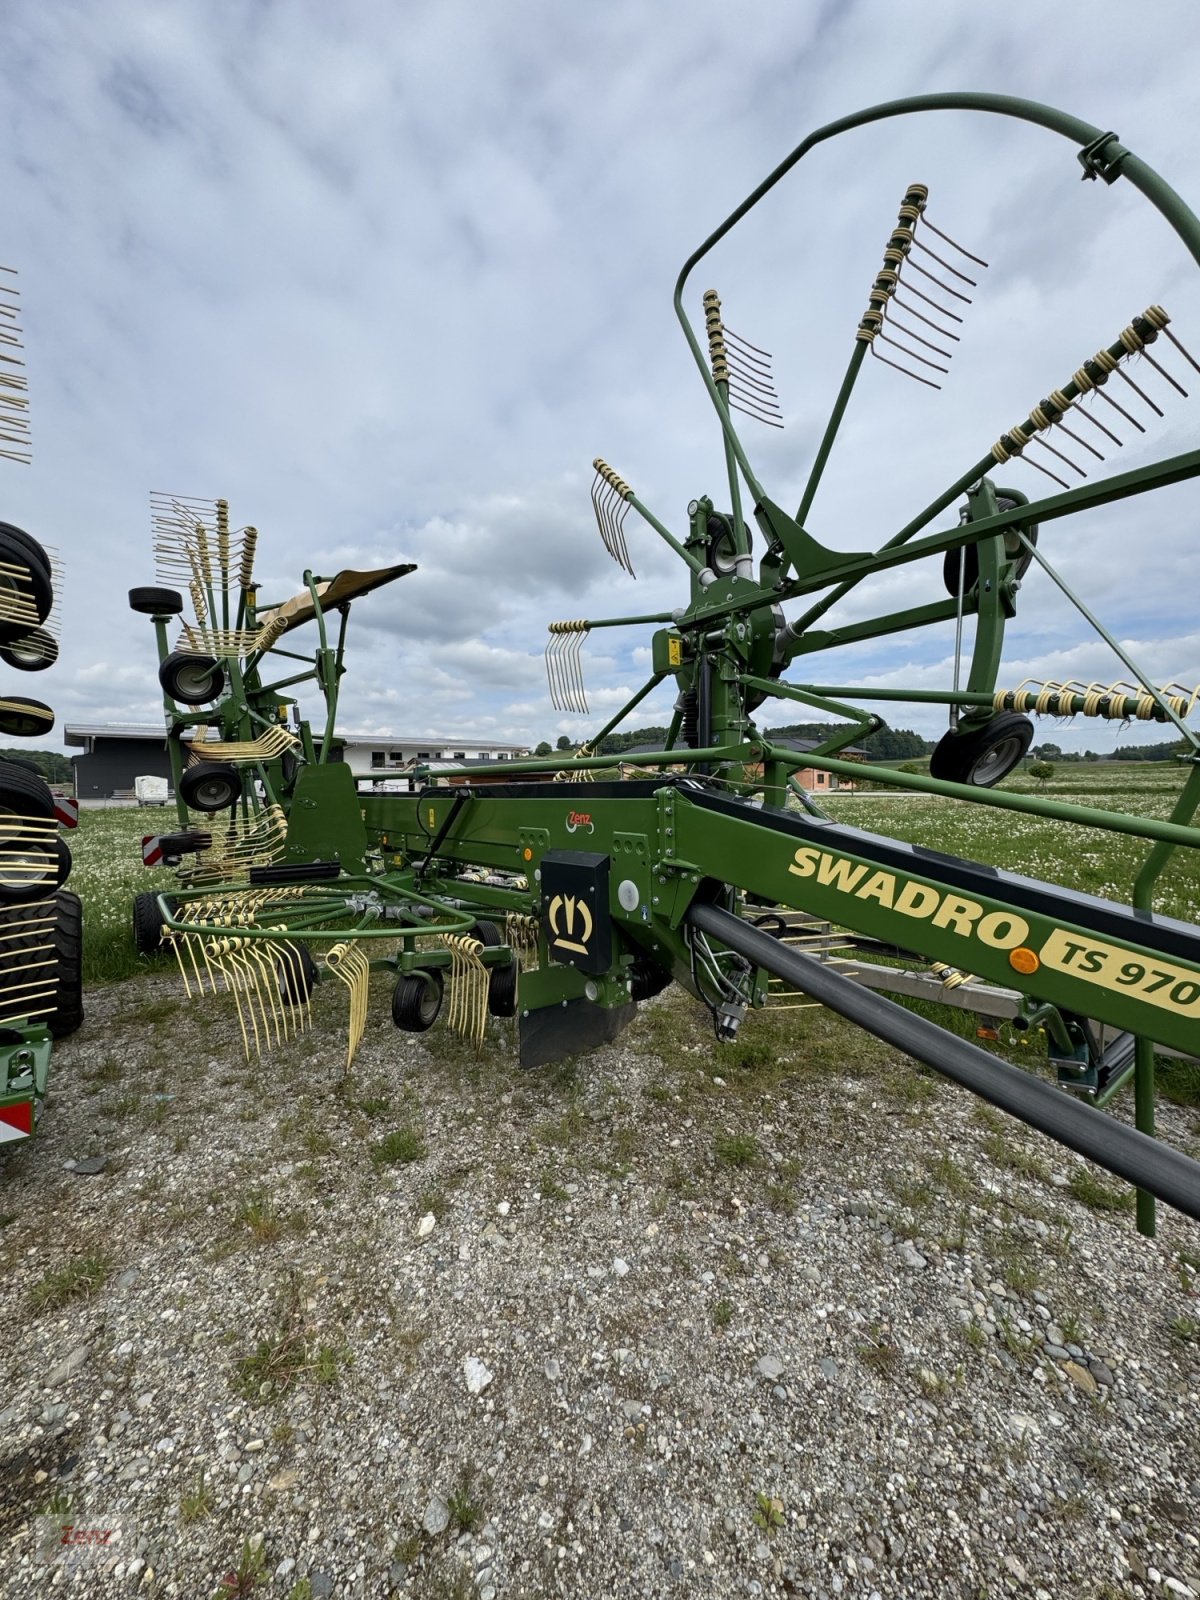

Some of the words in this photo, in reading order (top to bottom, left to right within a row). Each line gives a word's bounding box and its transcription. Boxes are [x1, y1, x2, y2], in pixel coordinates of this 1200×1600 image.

[569, 810, 592, 825] Zenz
[788, 847, 1030, 951] SWADRO
[1061, 941, 1109, 973] TS
[1115, 962, 1200, 1005] 970
